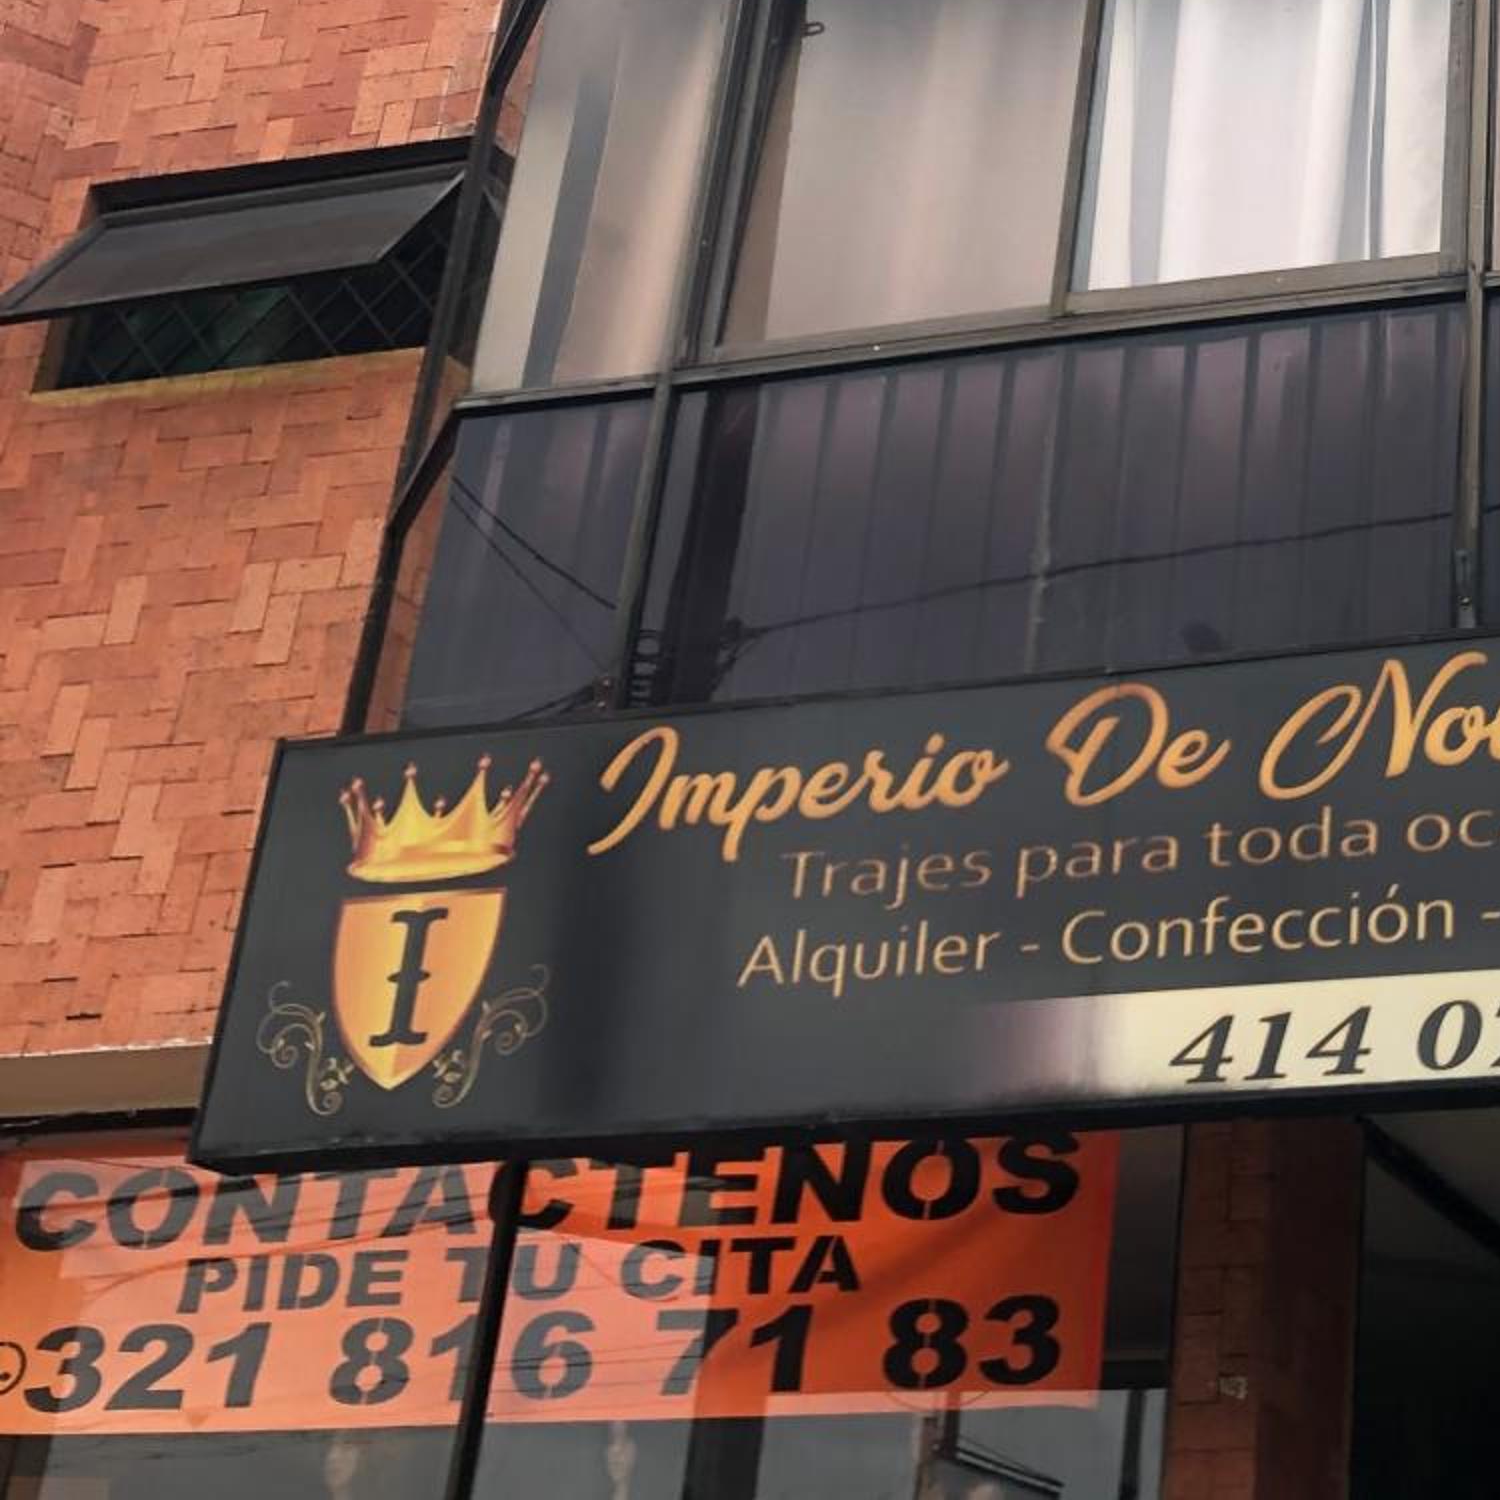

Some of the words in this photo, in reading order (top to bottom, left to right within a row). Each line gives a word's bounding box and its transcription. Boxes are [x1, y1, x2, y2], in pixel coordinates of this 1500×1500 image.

[587, 726, 1008, 861] Imperio
[1046, 681, 1231, 807] De
[781, 844, 991, 909] Trajes
[1015, 831, 1179, 895] para
[1205, 805, 1377, 867] toda
[369, 907, 448, 1048] I
[737, 920, 1001, 997] Alquiler
[1061, 884, 1454, 965] Confección
[1169, 1004, 1372, 1084] 414
[176, 1250, 408, 1314] PIDE
[444, 1243, 582, 1302] TU
[620, 1235, 860, 1299] CITA
[23, 1321, 272, 1414] 321
[329, 1311, 595, 1405] 816
[657, 1304, 814, 1397] 71
[883, 1295, 1061, 1390] 83
